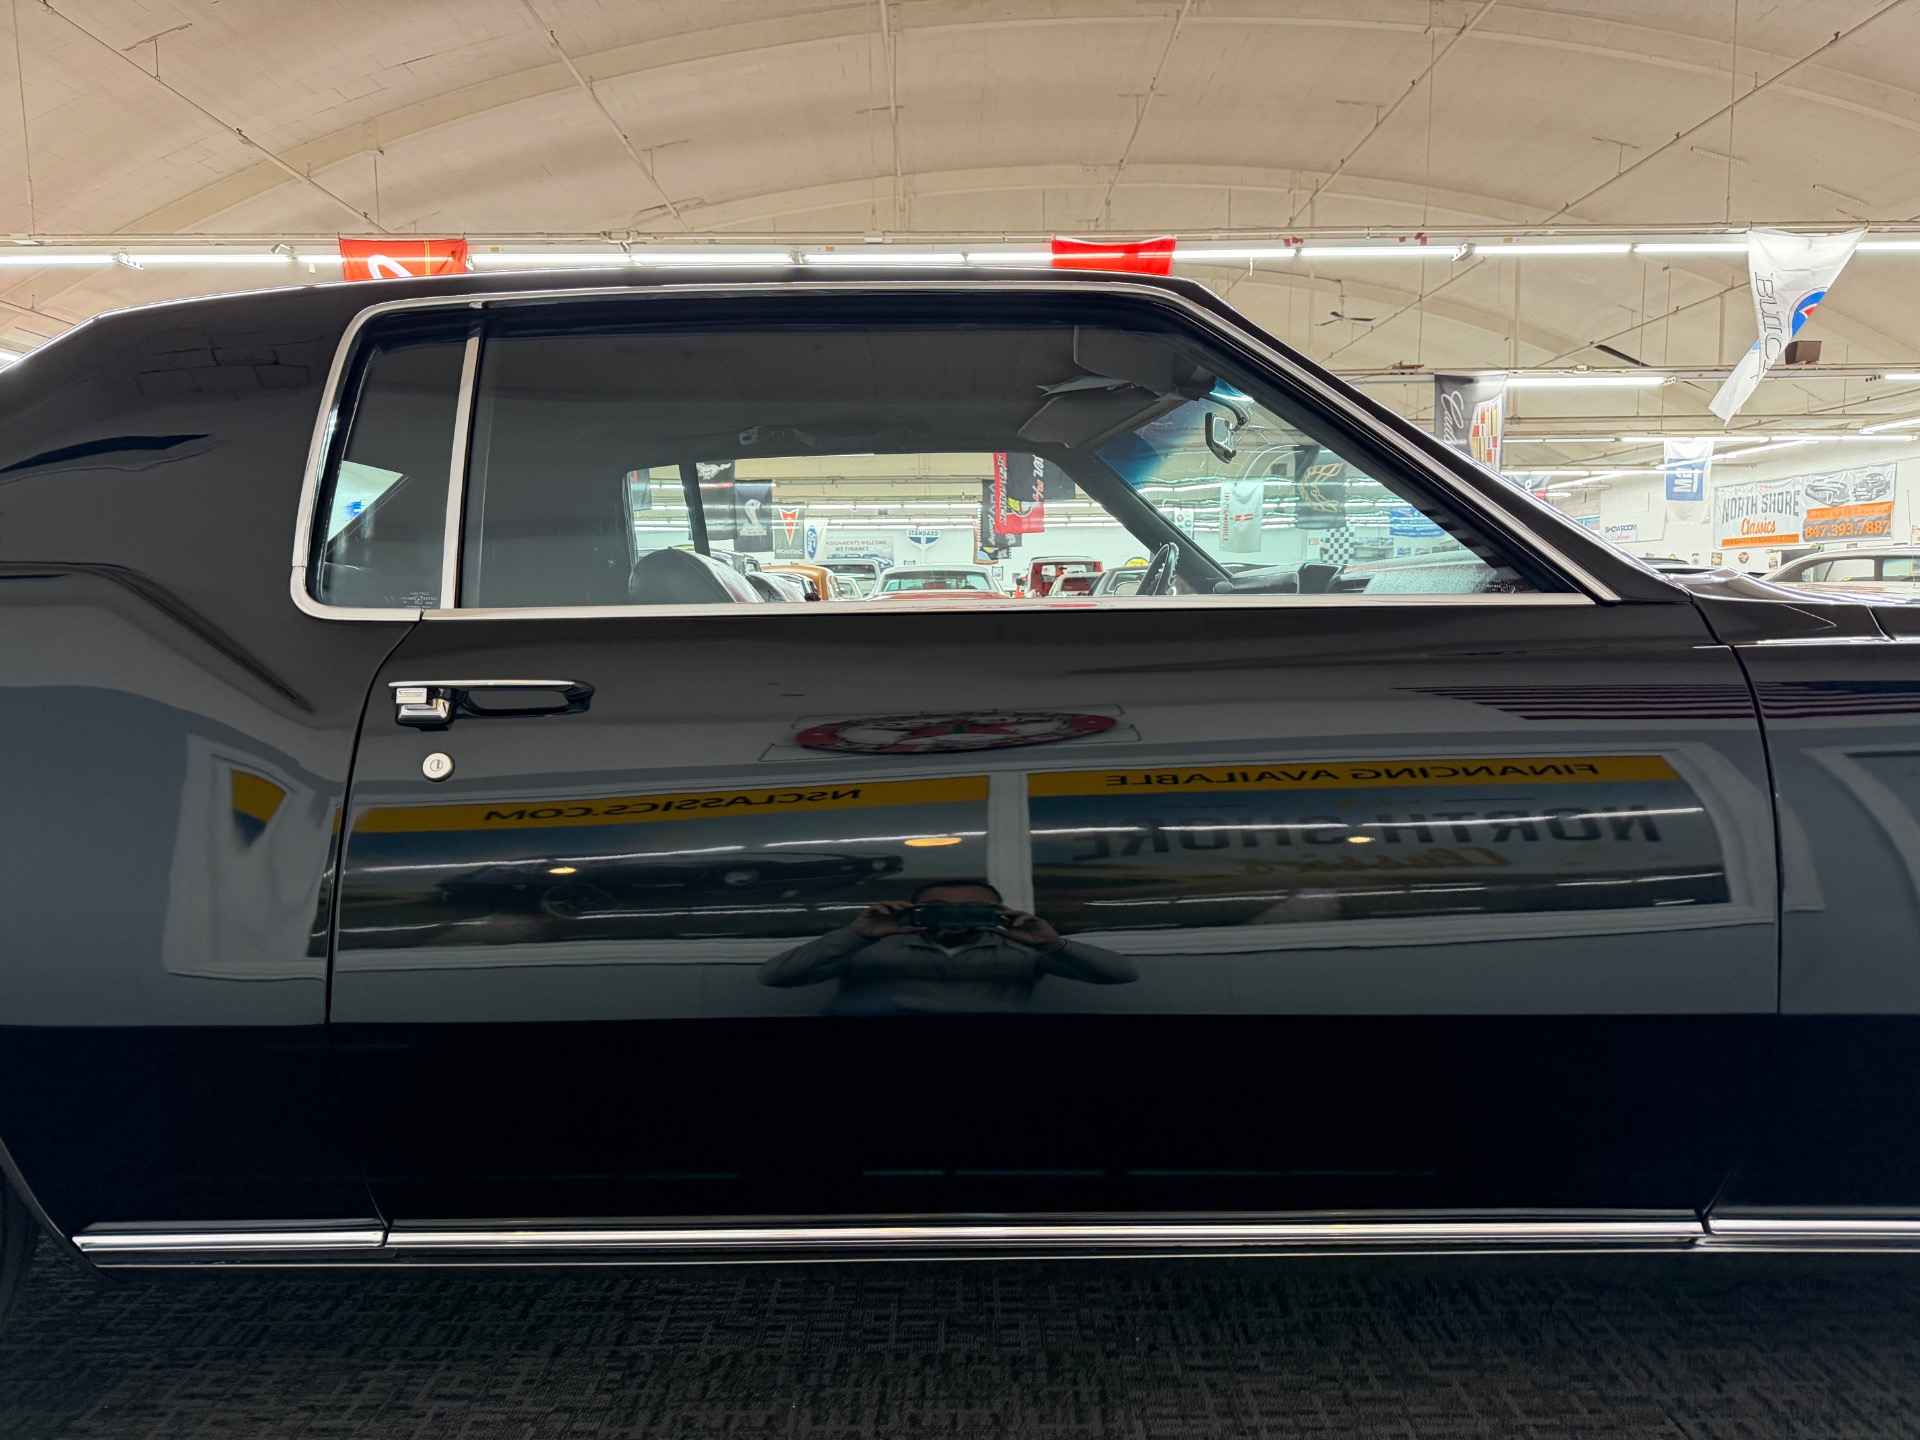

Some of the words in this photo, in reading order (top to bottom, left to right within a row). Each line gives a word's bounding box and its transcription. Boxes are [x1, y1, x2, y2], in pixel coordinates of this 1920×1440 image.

[1721, 496, 1758, 524] NORTH
[1761, 489, 1800, 518] SHORE
[1741, 516, 1777, 536] Classics
[1804, 519, 1891, 539] 847.393.7887
